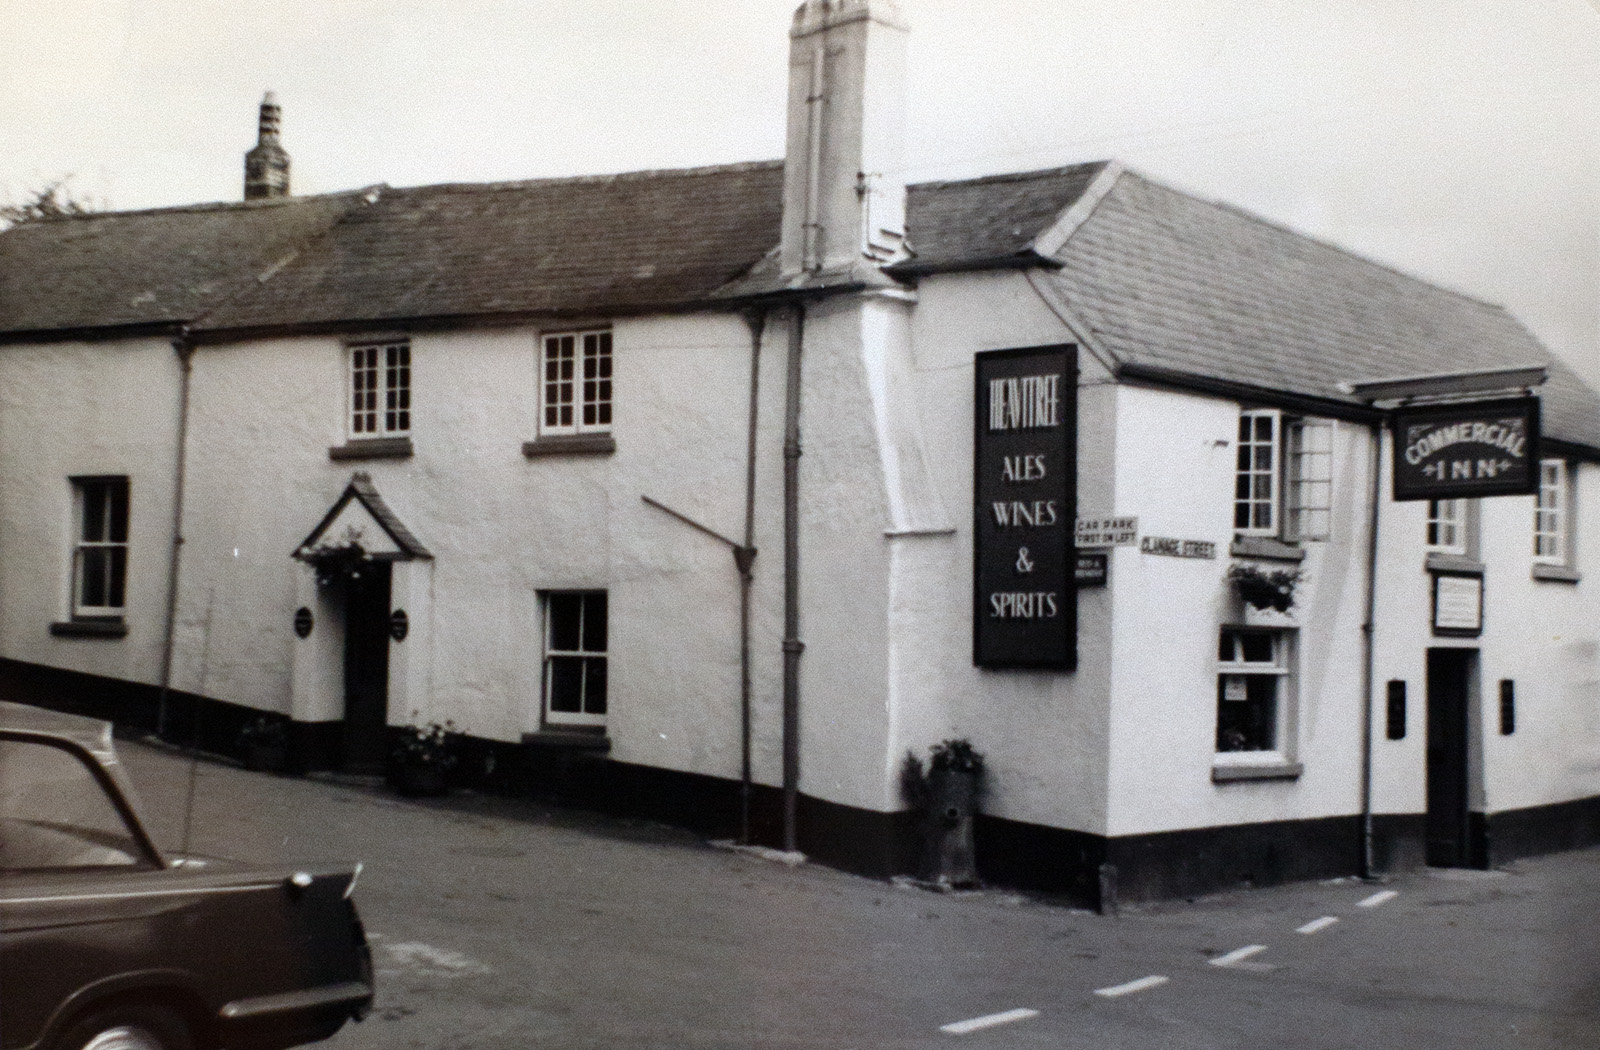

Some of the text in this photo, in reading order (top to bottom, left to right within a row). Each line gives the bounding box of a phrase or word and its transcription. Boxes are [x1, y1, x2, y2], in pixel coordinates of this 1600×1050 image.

[1405, 421, 1525, 465] COMMERCIAL
[1002, 455, 1046, 481] ALES
[1437, 459, 1497, 480] INN
[993, 501, 1057, 526] WINES
[1078, 519, 1134, 531] CAR PARK
[1078, 533, 1100, 543] FIRST
[1115, 532, 1136, 543] LEFT
[1182, 541, 1215, 558] STREET
[1016, 546, 1034, 572] &
[990, 592, 1058, 618] SPIRITS
